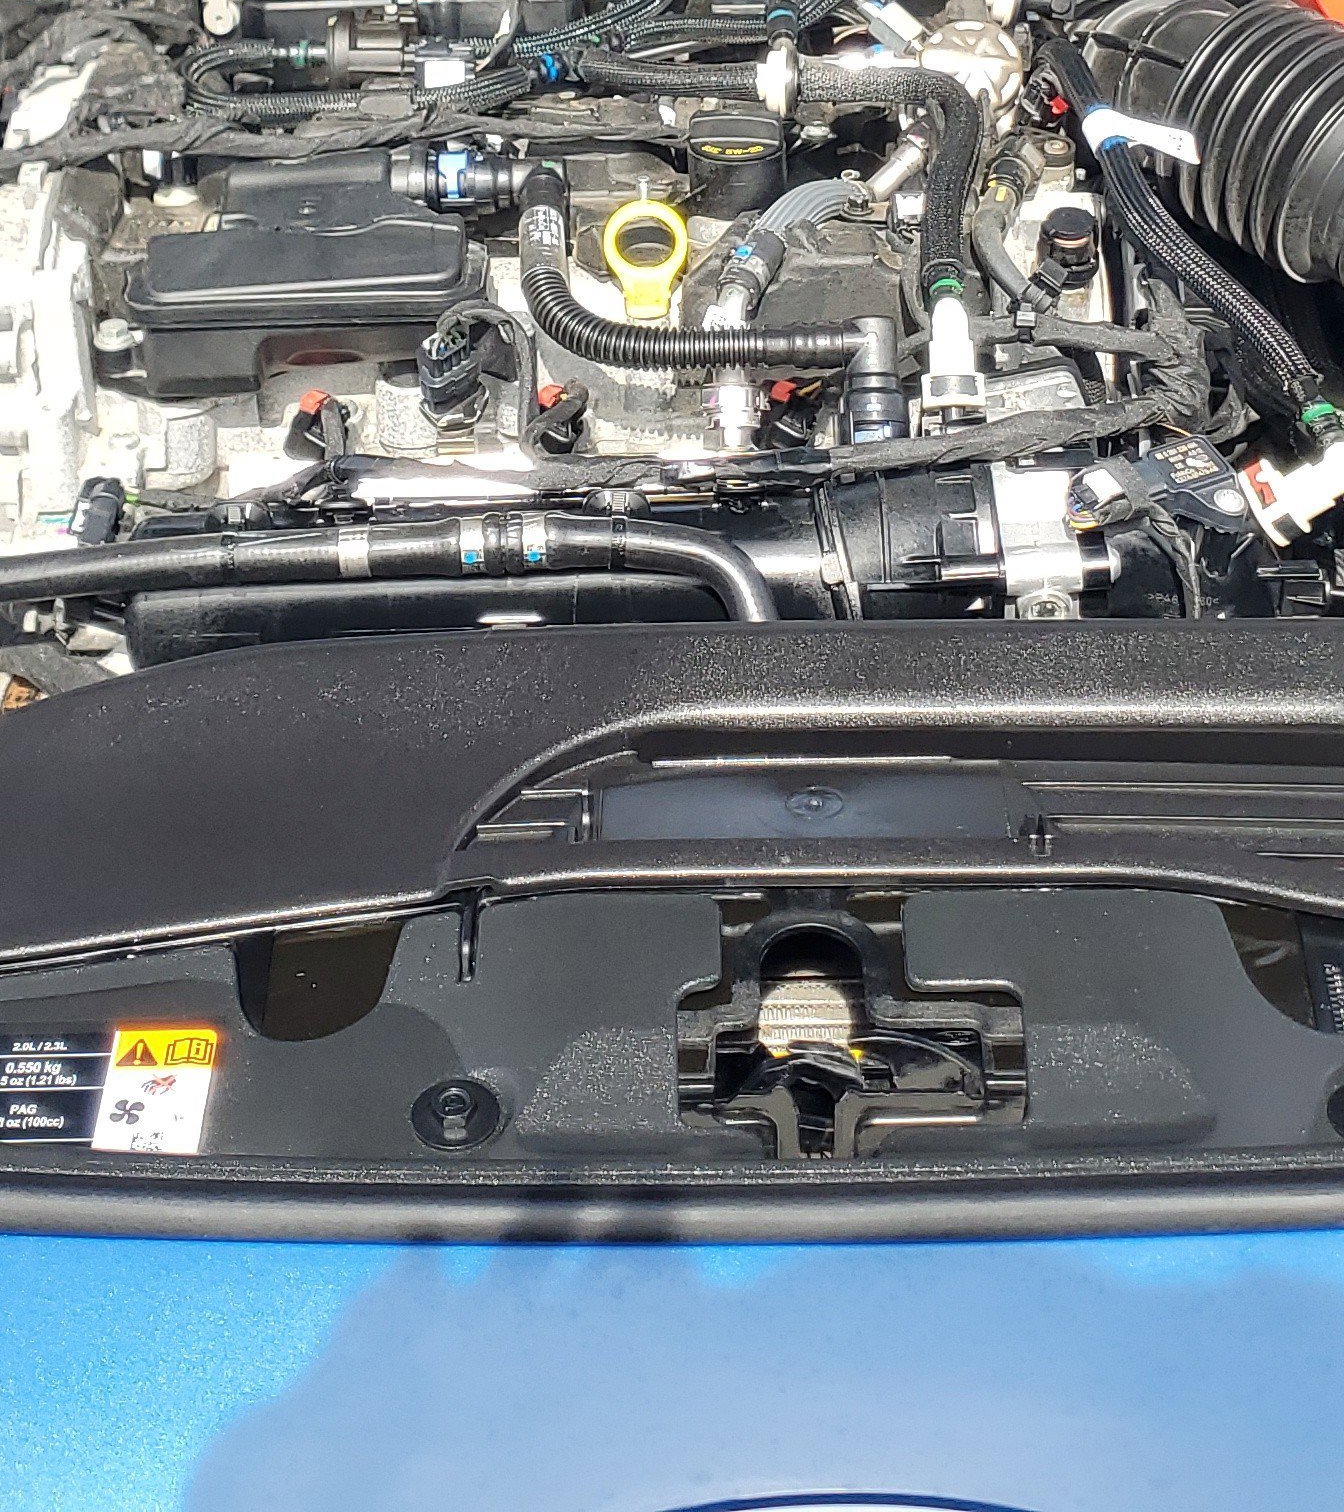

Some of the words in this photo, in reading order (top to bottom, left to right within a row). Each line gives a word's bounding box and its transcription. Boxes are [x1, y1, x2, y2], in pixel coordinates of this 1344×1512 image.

[12, 1042, 36, 1052] 2.0L
[44, 1041, 68, 1051] 2.3L
[5, 1062, 42, 1074] 0.550
[44, 1061, 62, 1076] kg
[10, 1078, 25, 1086] oz
[26, 1075, 53, 1088] (1.21
[55, 1075, 78, 1087] lbs)
[9, 1104, 38, 1115] PAG
[6, 1120, 22, 1128] oz
[23, 1116, 65, 1129] (100cc)
